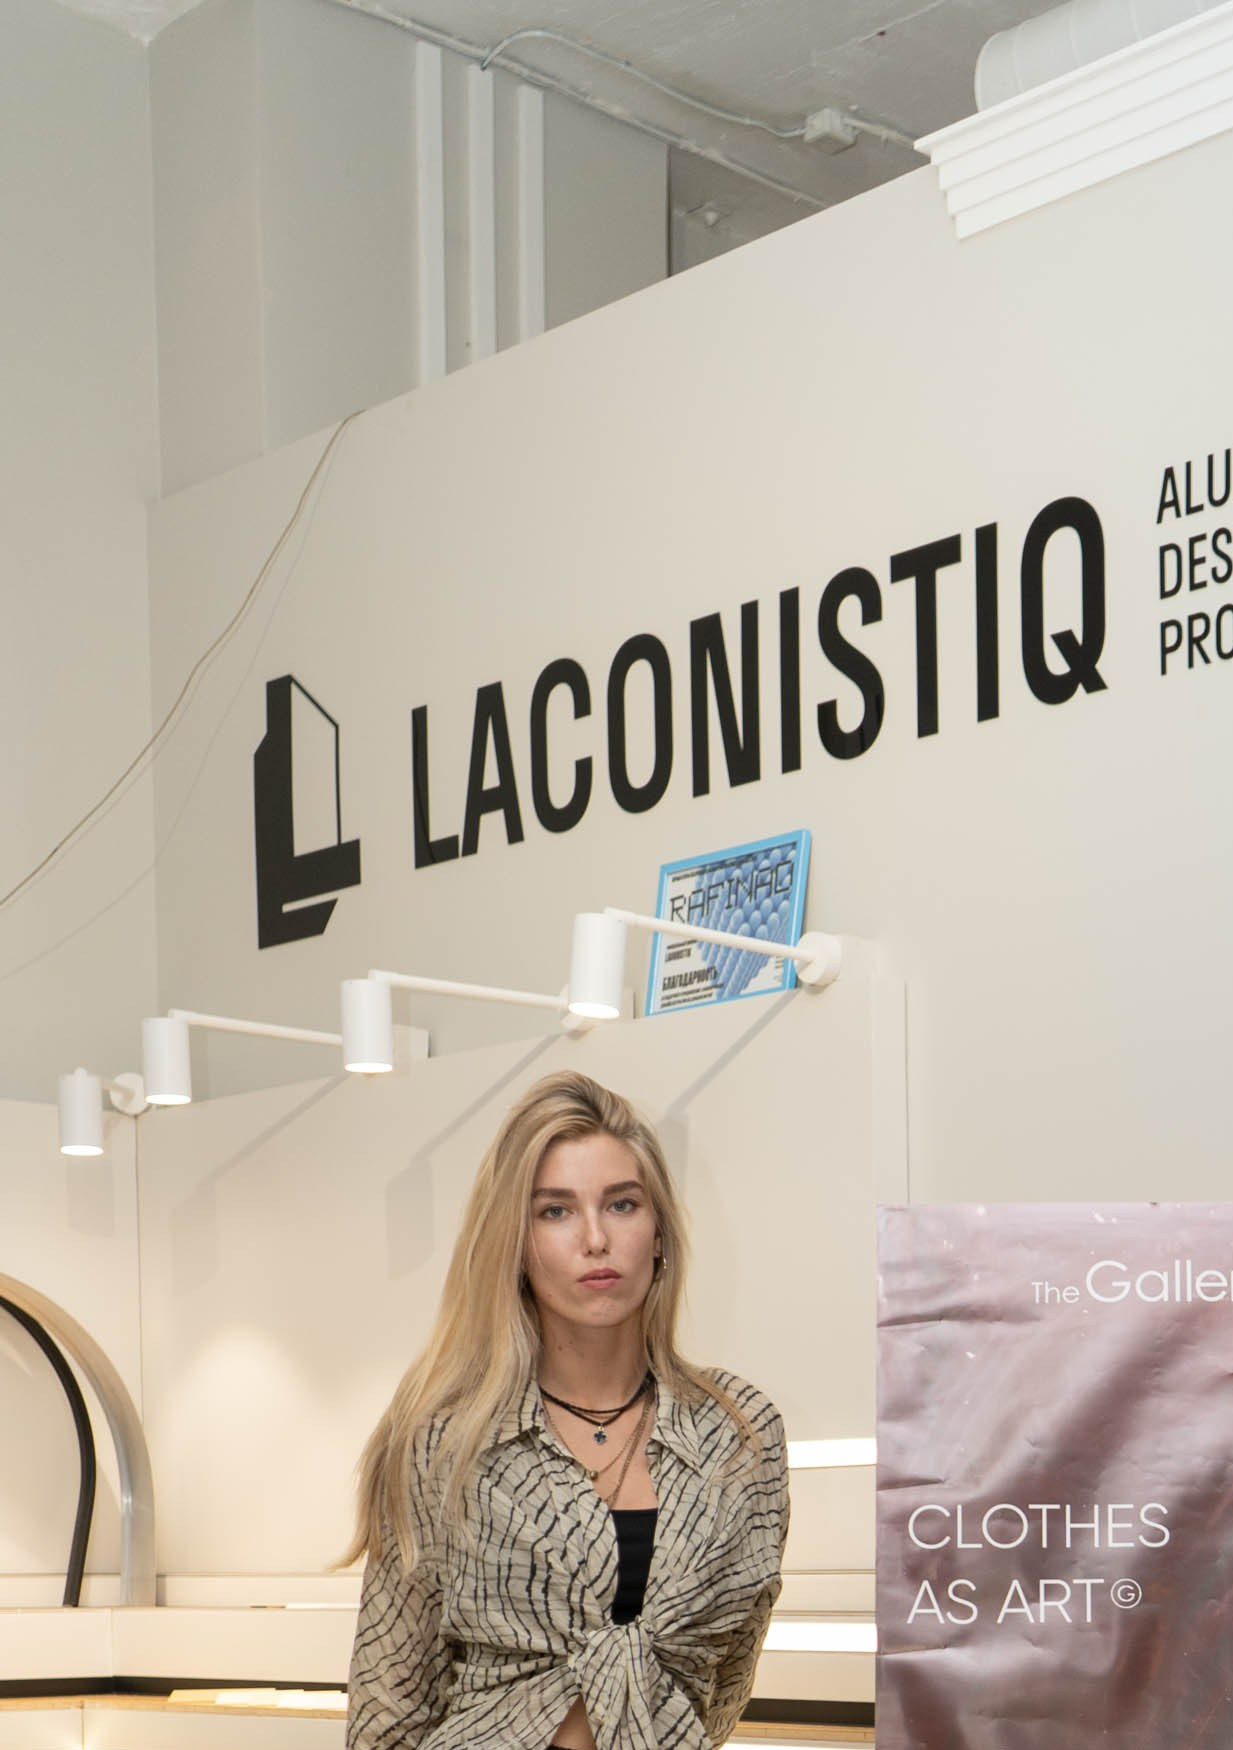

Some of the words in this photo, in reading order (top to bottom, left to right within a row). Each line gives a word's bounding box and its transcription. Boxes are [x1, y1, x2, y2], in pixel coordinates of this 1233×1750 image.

[411, 496, 1109, 869] LACONISTIQ
[1031, 1281, 1080, 1304] The
[908, 1503, 1170, 1549] CLOTHES
[906, 1579, 978, 1624] AS
